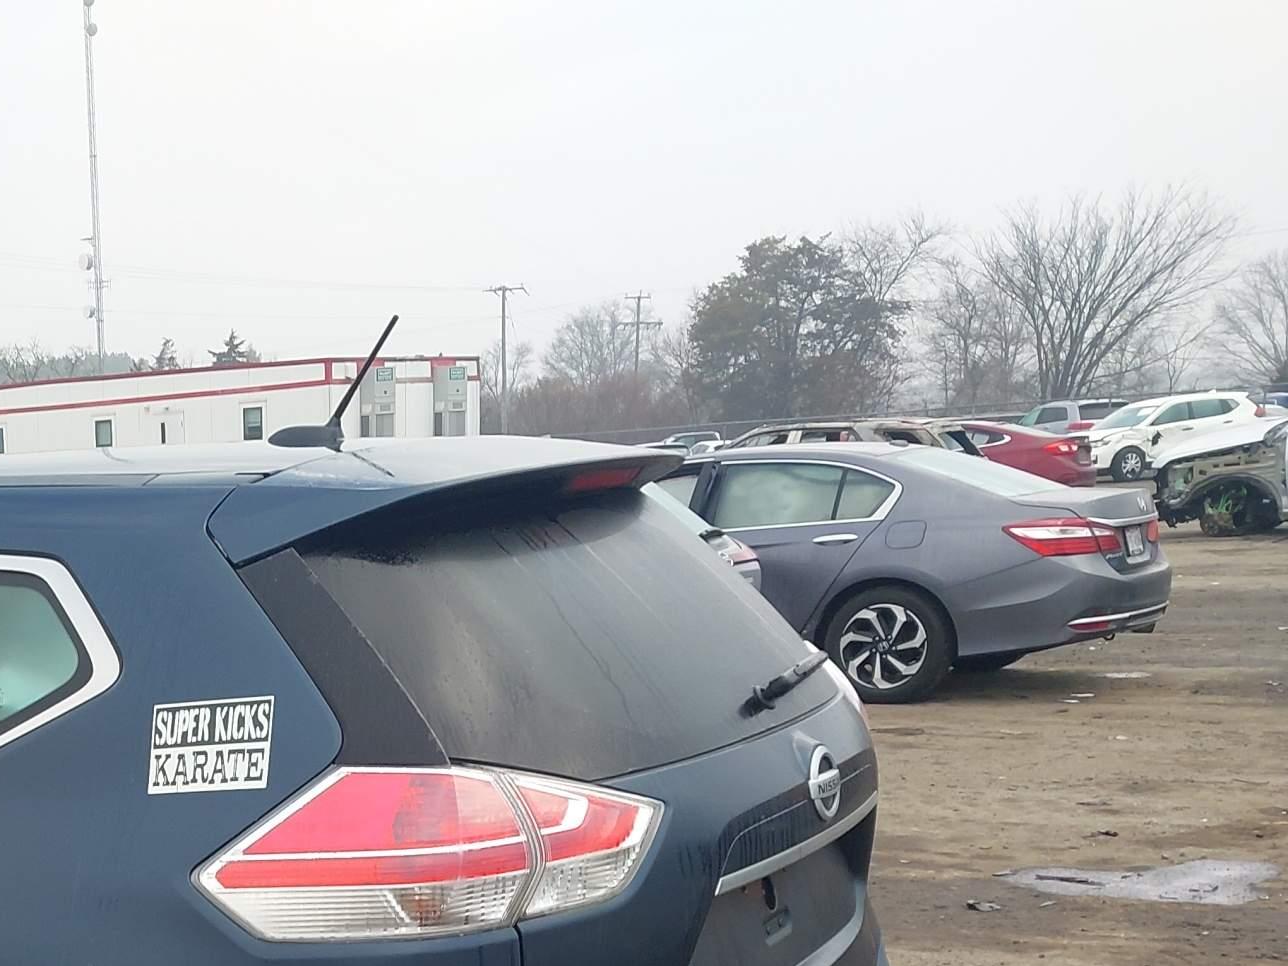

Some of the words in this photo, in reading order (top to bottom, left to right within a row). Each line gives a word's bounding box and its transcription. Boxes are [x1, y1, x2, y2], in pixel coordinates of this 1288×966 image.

[155, 707, 211, 746] SUPER
[215, 702, 270, 742] KICKS
[153, 748, 265, 787] KARATE
